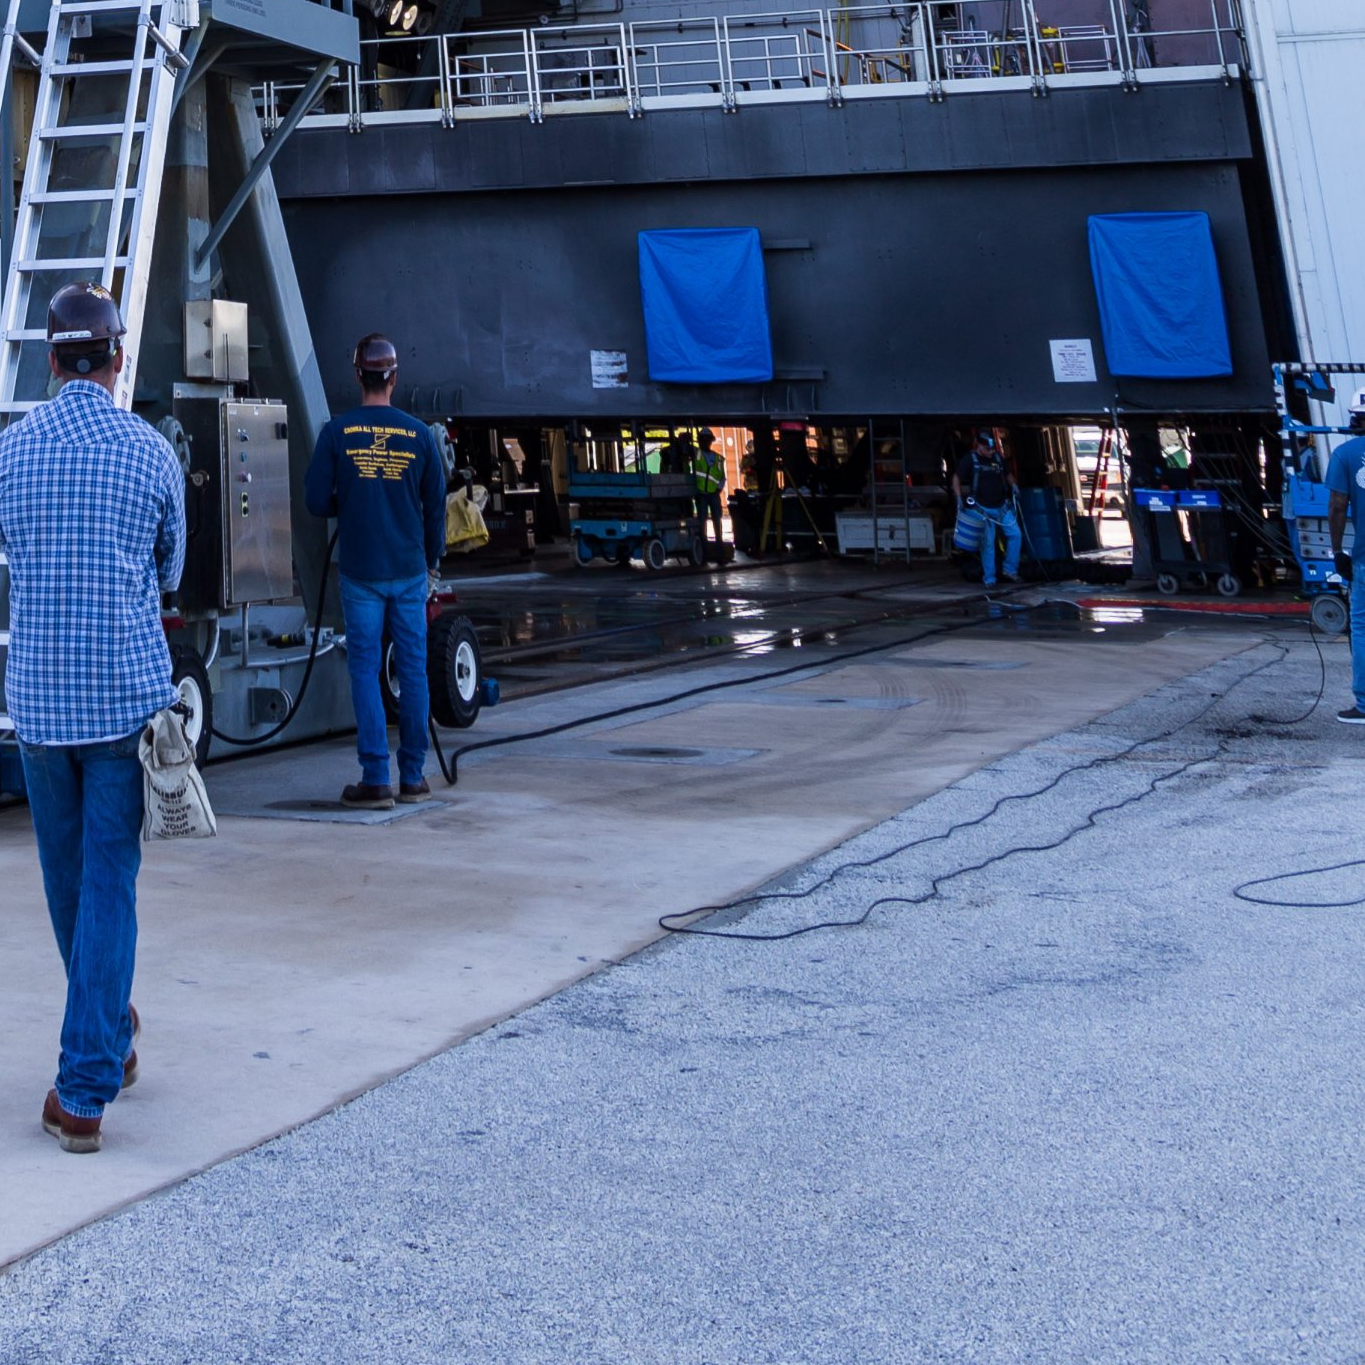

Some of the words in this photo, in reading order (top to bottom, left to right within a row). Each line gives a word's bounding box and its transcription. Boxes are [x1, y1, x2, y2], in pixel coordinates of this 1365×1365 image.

[157, 803, 192, 814] ALWAYS
[161, 813, 188, 822] WEAR
[164, 821, 189, 830] YOUR
[160, 826, 196, 837] GLOVES
